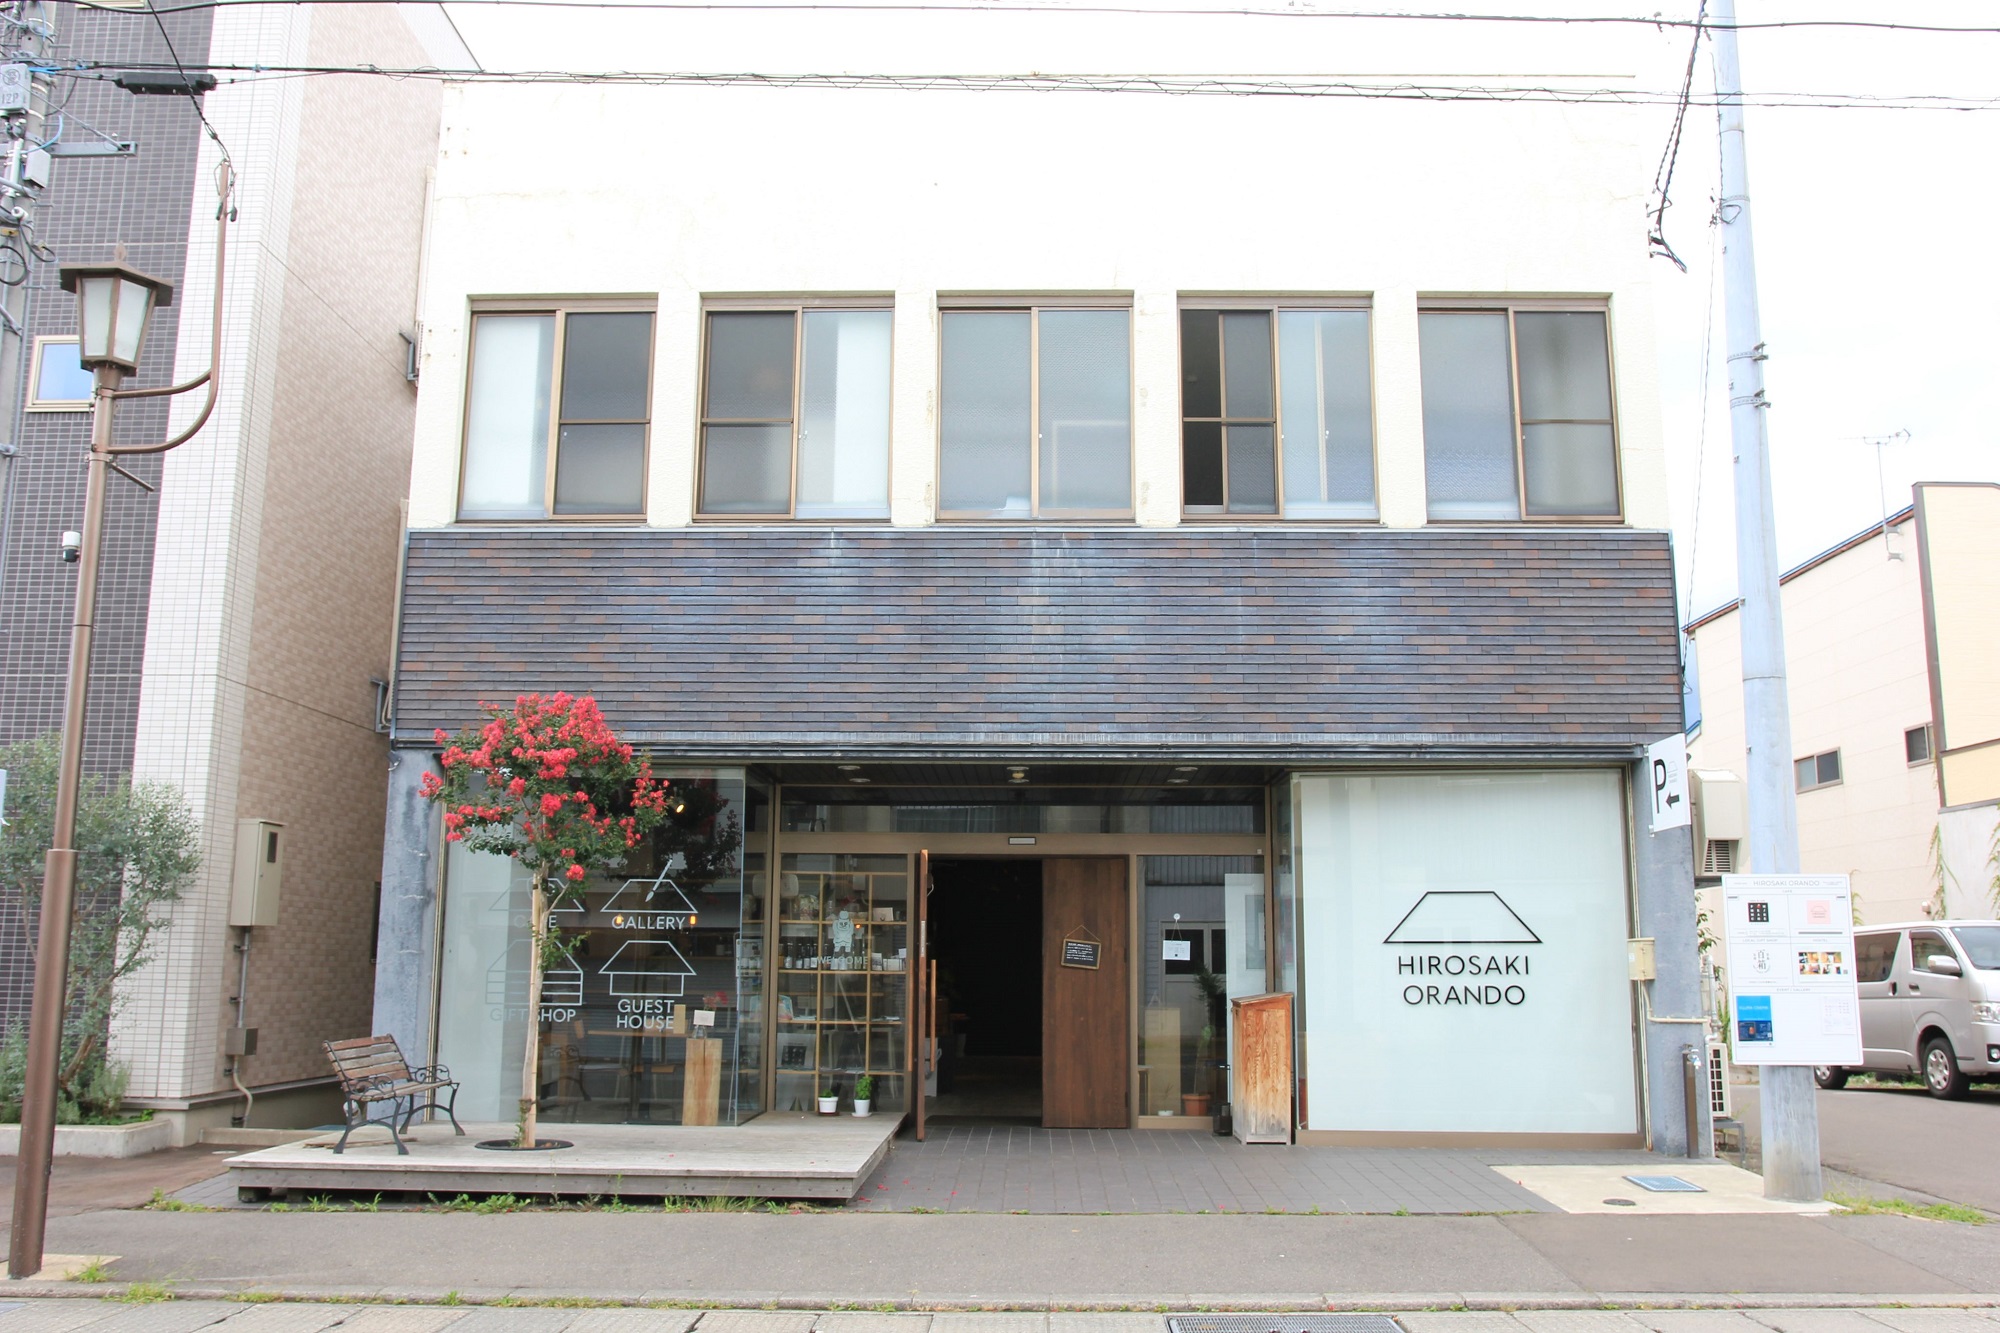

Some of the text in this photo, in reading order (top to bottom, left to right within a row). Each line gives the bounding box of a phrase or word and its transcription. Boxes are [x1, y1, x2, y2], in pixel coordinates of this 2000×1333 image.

[1653, 758, 1667, 814] P
[513, 914, 558, 929] CE
[611, 915, 686, 930] GALLERY
[817, 956, 868, 965] WELCOME
[1398, 955, 1529, 975] HIROSAKI
[1403, 984, 1526, 1006] ORANDO
[617, 998, 675, 1013] GUEST
[616, 1014, 674, 1029] HOUSE
